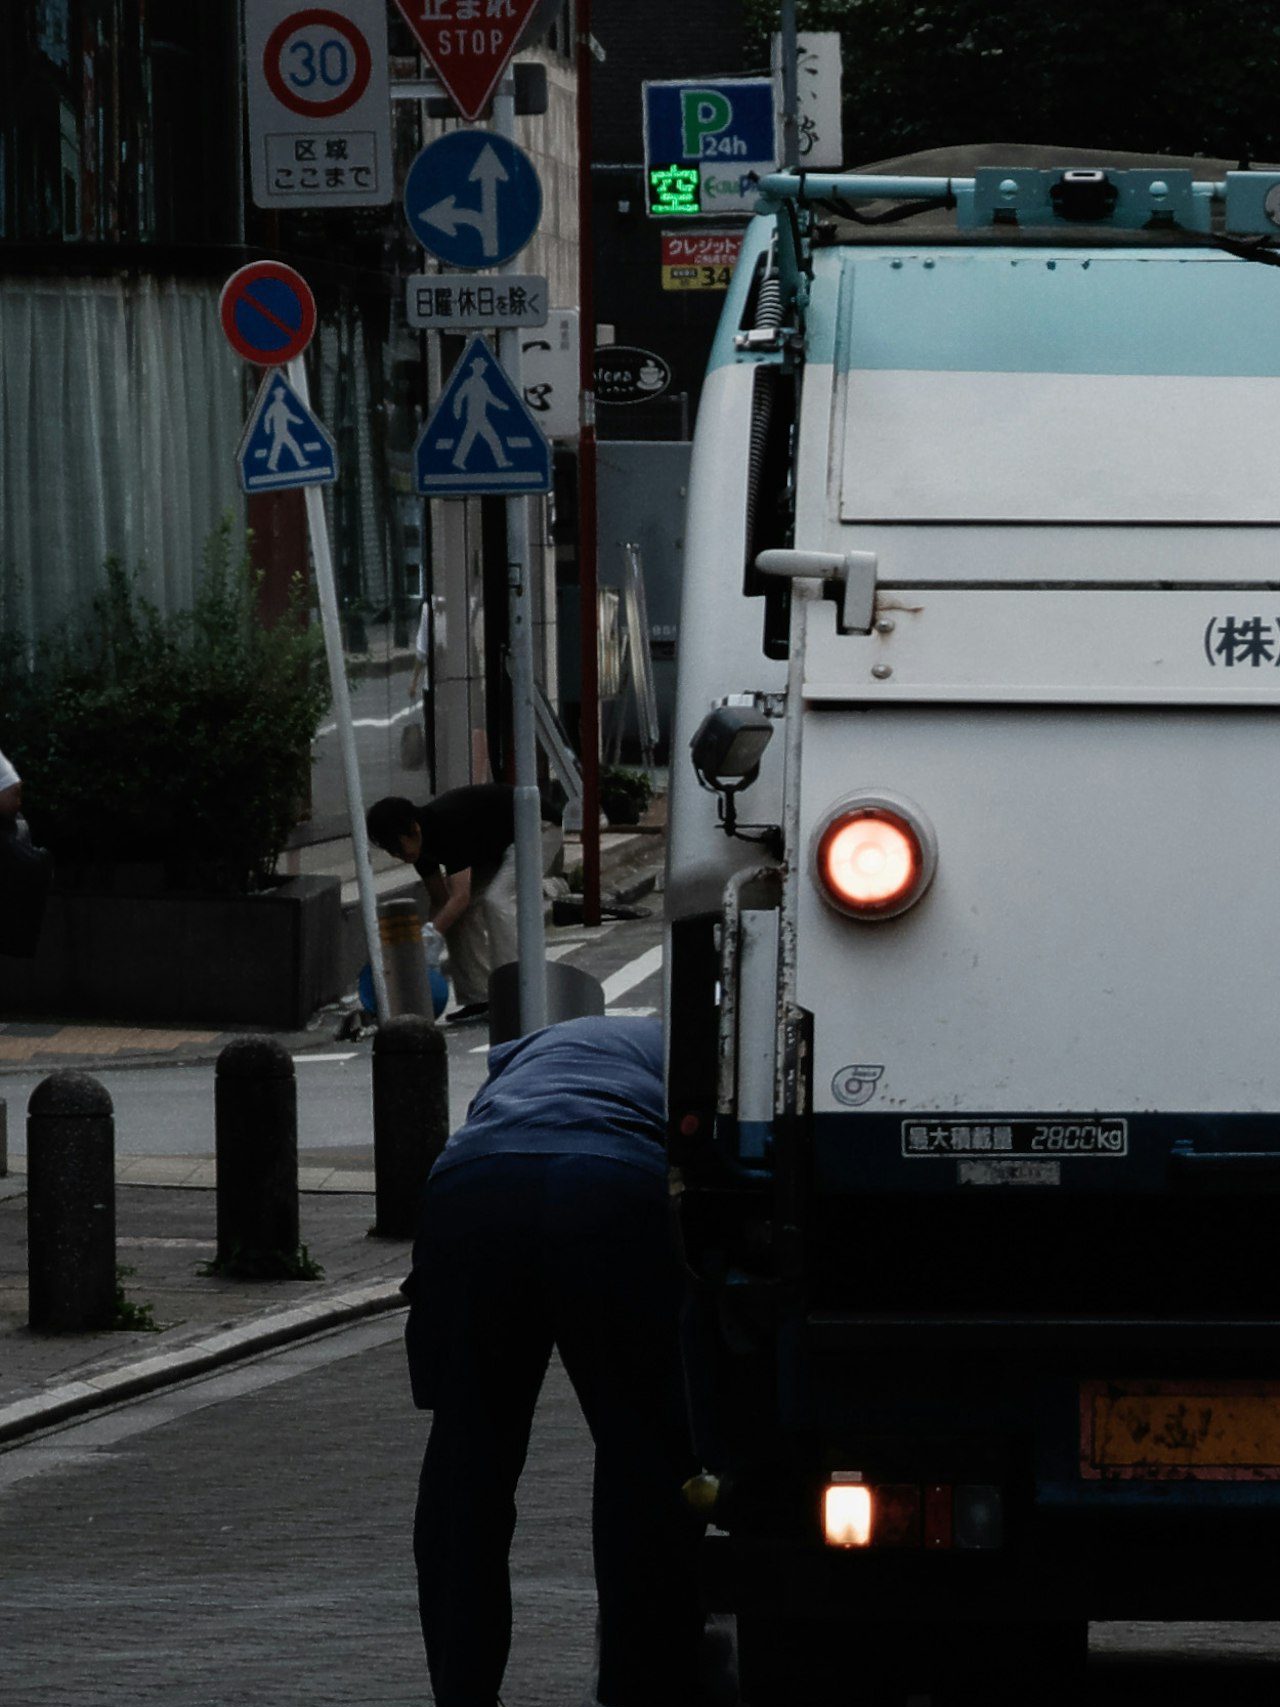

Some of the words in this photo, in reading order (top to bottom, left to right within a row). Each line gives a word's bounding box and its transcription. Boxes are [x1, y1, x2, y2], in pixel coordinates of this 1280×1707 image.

[438, 29, 504, 56] STOP
[289, 40, 347, 87] 30
[680, 89, 733, 159] P
[295, 139, 348, 161] 区域
[704, 136, 748, 157] 24h
[275, 166, 371, 188] ここまで
[669, 237, 742, 256] クレジット
[908, 1126, 1014, 1151] 最大積載量
